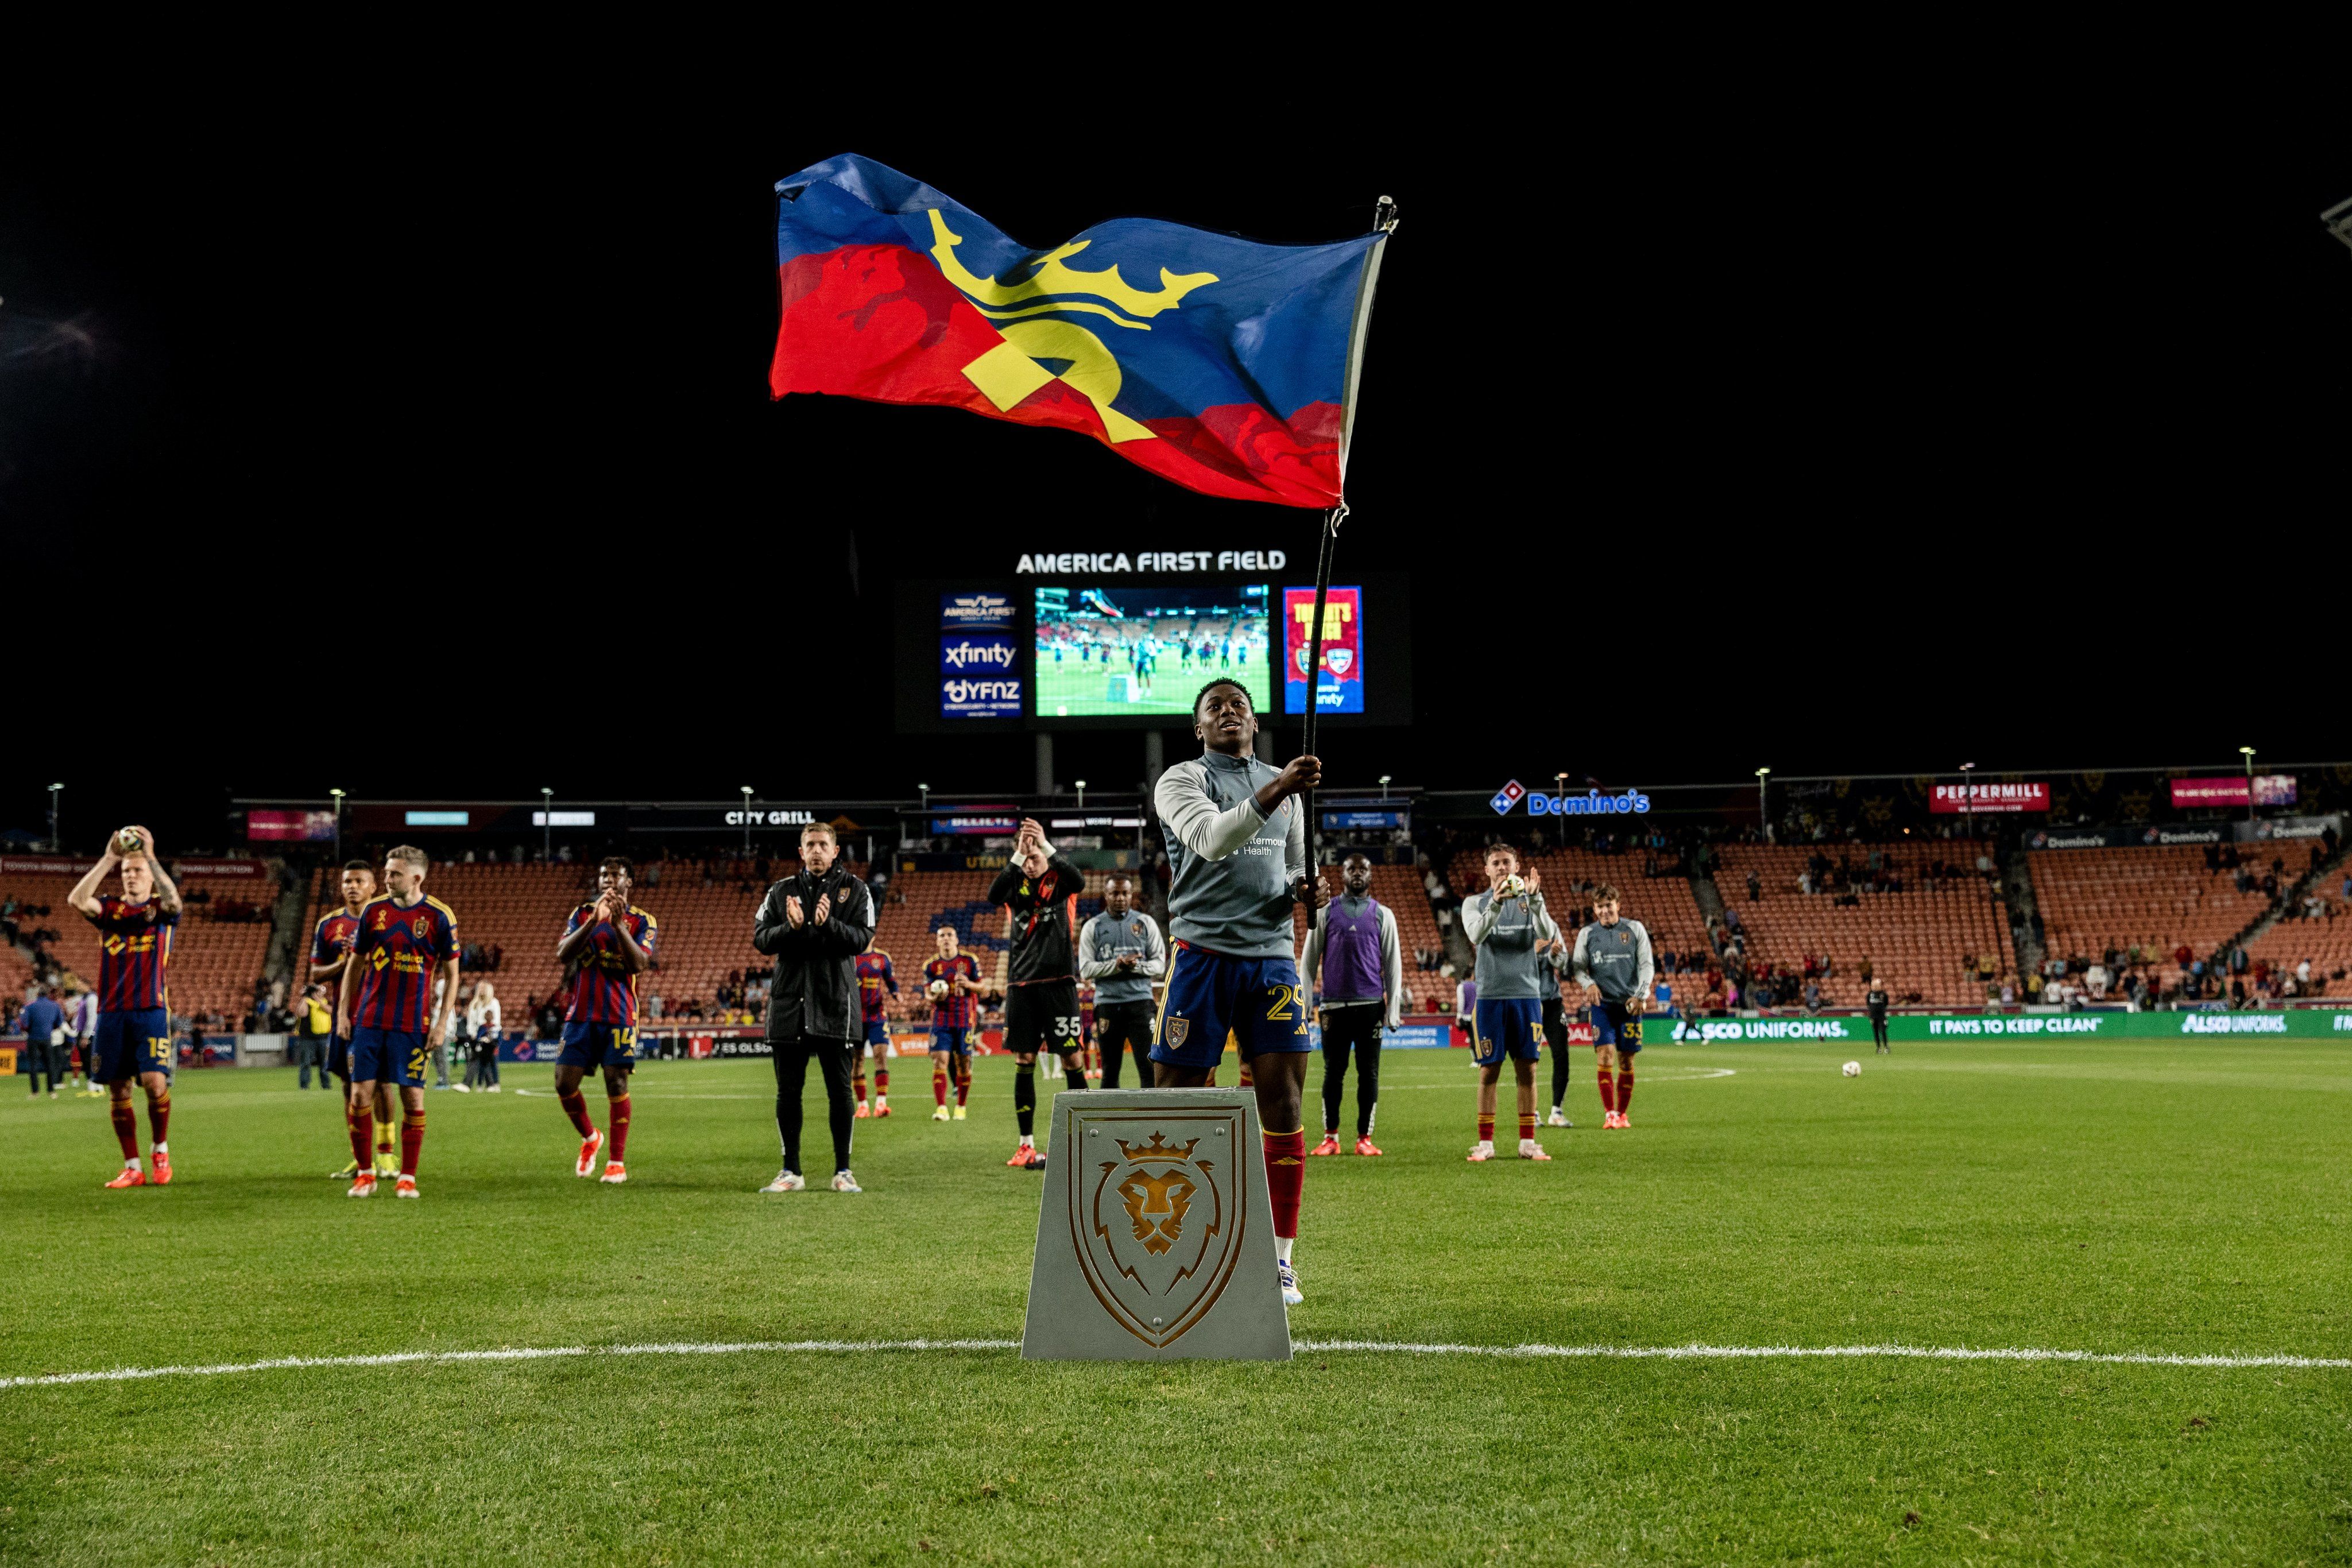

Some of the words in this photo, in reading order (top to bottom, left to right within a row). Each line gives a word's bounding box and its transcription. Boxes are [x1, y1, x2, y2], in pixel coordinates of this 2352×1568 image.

[1016, 553, 1132, 574] AMERICA
[1137, 552, 1213, 572] FIRST
[1218, 551, 1286, 570] FIELD
[943, 607, 987, 617] AMERICA
[988, 606, 1016, 616] FIRST
[945, 641, 1017, 668] xfinity
[1937, 784, 2042, 799] PEPPERMILL
[1527, 788, 1650, 816] Domino's
[725, 811, 765, 825] CITY
[768, 811, 816, 825] GRILL
[2048, 835, 2106, 848] Domino's
[1244, 846, 1272, 855] Health
[394, 951, 424, 964] Select
[393, 962, 424, 973] Health
[1267, 984, 1306, 1020] 29
[1054, 1016, 1081, 1036] 35
[1930, 1020, 1943, 1034] IT
[1945, 1020, 1981, 1034] PAYS
[1982, 1019, 2004, 1033] TO
[2006, 1018, 2044, 1033] KEEP
[611, 1028, 636, 1049] 14
[148, 1037, 171, 1058] 15
